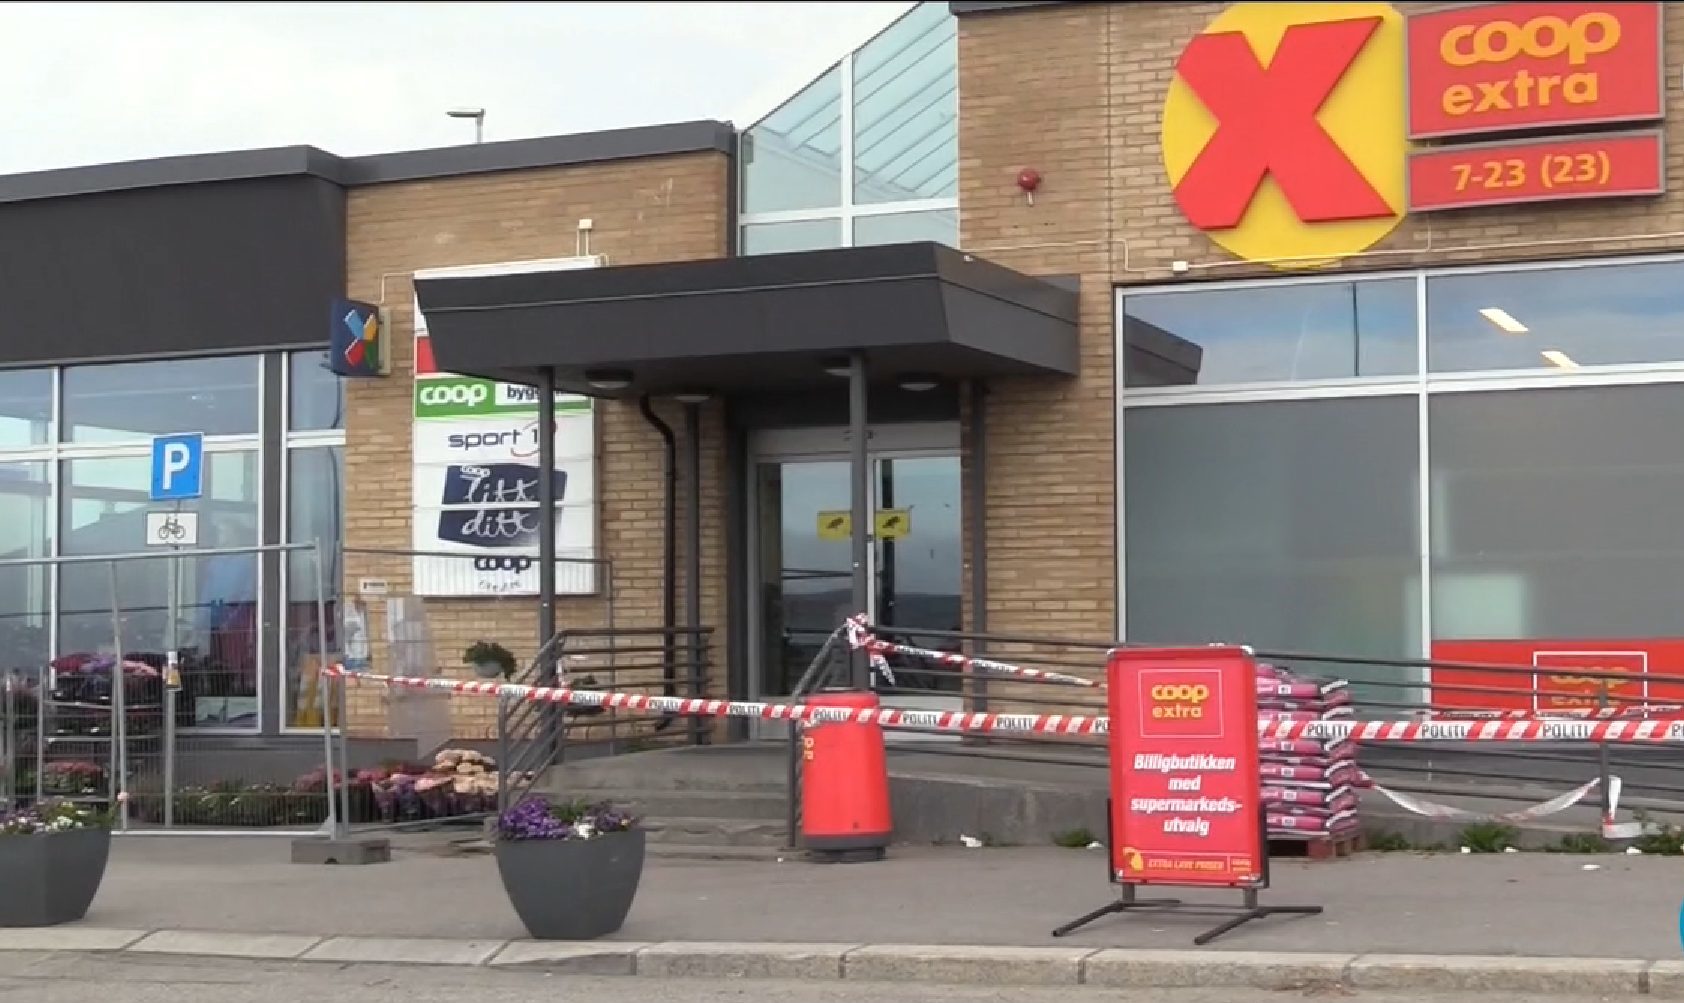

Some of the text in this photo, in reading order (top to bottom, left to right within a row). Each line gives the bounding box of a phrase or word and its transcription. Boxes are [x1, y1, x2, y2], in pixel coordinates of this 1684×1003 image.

[1440, 12, 1621, 67] coop
[1442, 71, 1599, 116] extra
[1451, 151, 1610, 191] 7-23 (23)
[420, 384, 488, 406] coop
[448, 429, 522, 450] sport
[162, 442, 190, 490] P
[474, 555, 532, 574] coop
[1151, 684, 1209, 703] coop
[903, 712, 937, 725] POLITI
[1152, 705, 1202, 719] extra
[997, 716, 1032, 730] POLITI
[1307, 724, 1348, 737] POLITI
[1422, 724, 1465, 738] POLITI
[1543, 724, 1590, 738] POLITI
[1134, 754, 1235, 772] Billigbutikken
[1168, 775, 1201, 791] med
[1131, 796, 1243, 814] supermarkeds-
[1163, 817, 1210, 836] utvalg
